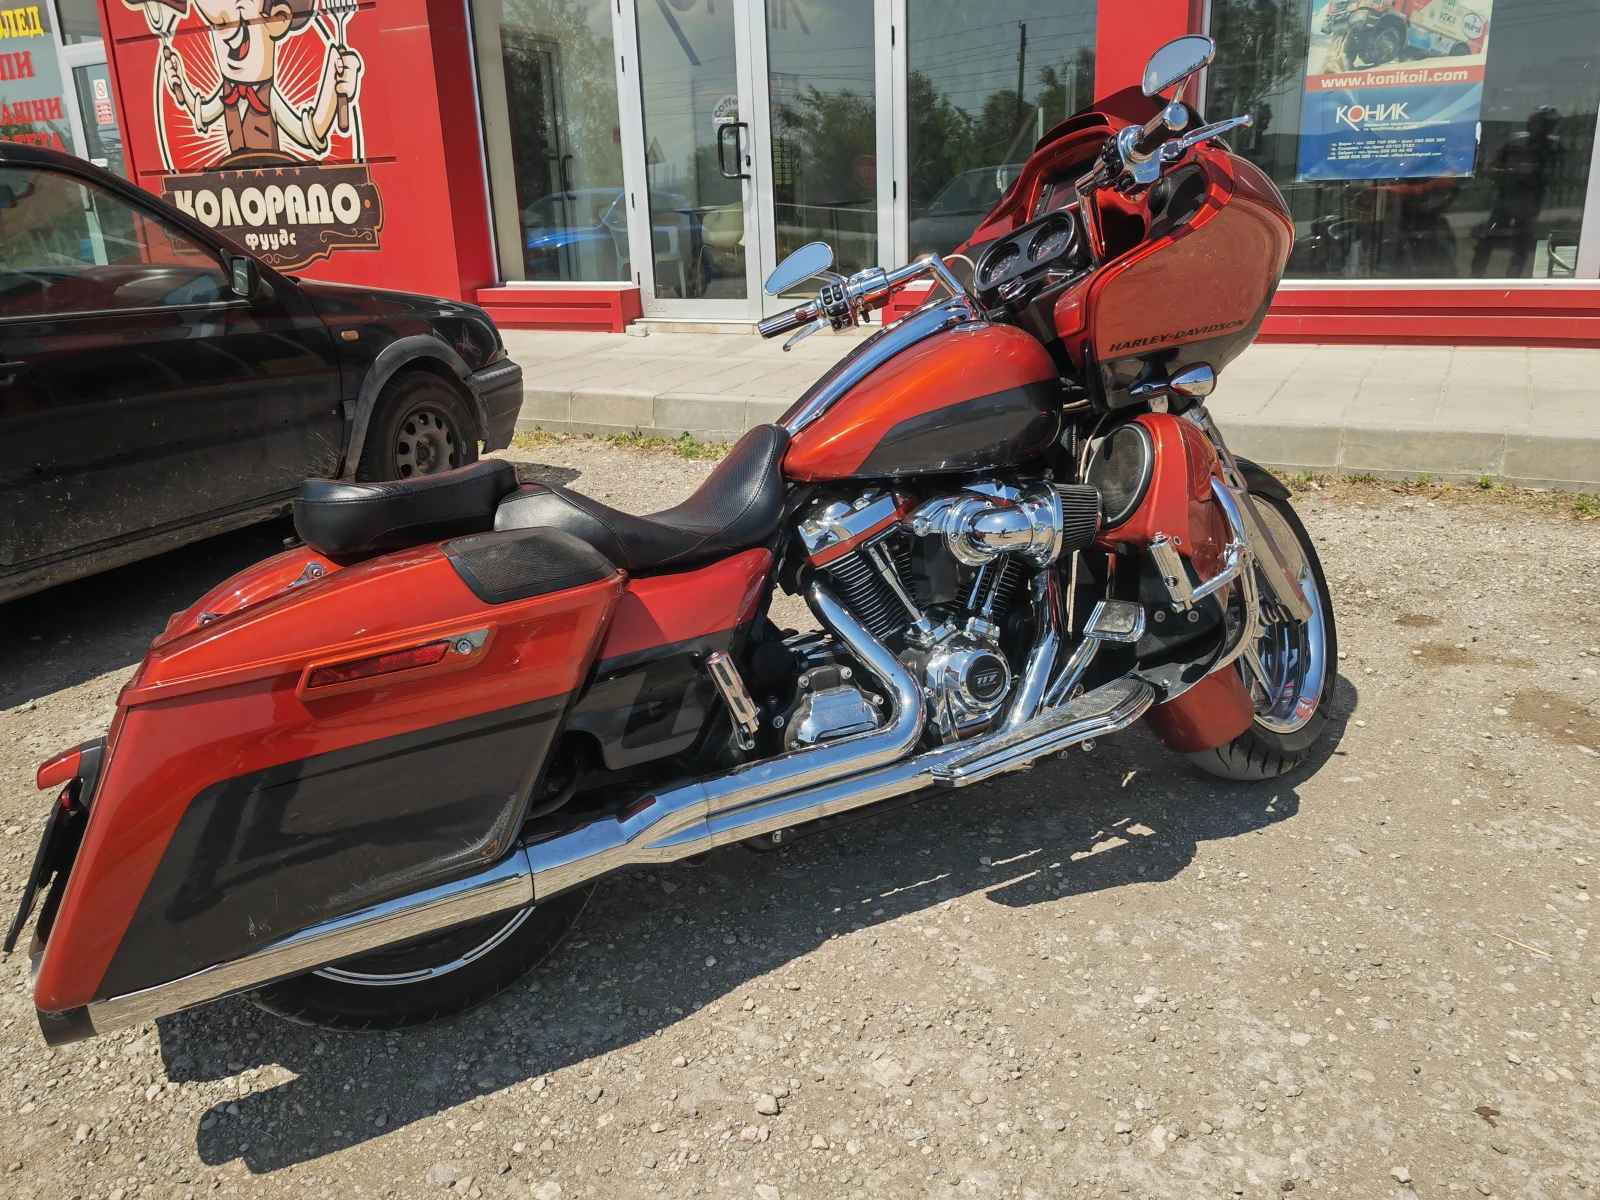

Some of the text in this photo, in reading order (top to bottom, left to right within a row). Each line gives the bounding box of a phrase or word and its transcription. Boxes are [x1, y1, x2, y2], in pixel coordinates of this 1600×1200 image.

[0, 6, 45, 39] ЛЕД
[1321, 70, 1468, 89] www.konikoil.com
[1335, 102, 1410, 132] КОНИК
[174, 182, 361, 228] КОЛОРАДО
[1108, 319, 1247, 352] HARLEY-DAVIDSON
[977, 673, 998, 685] 117
